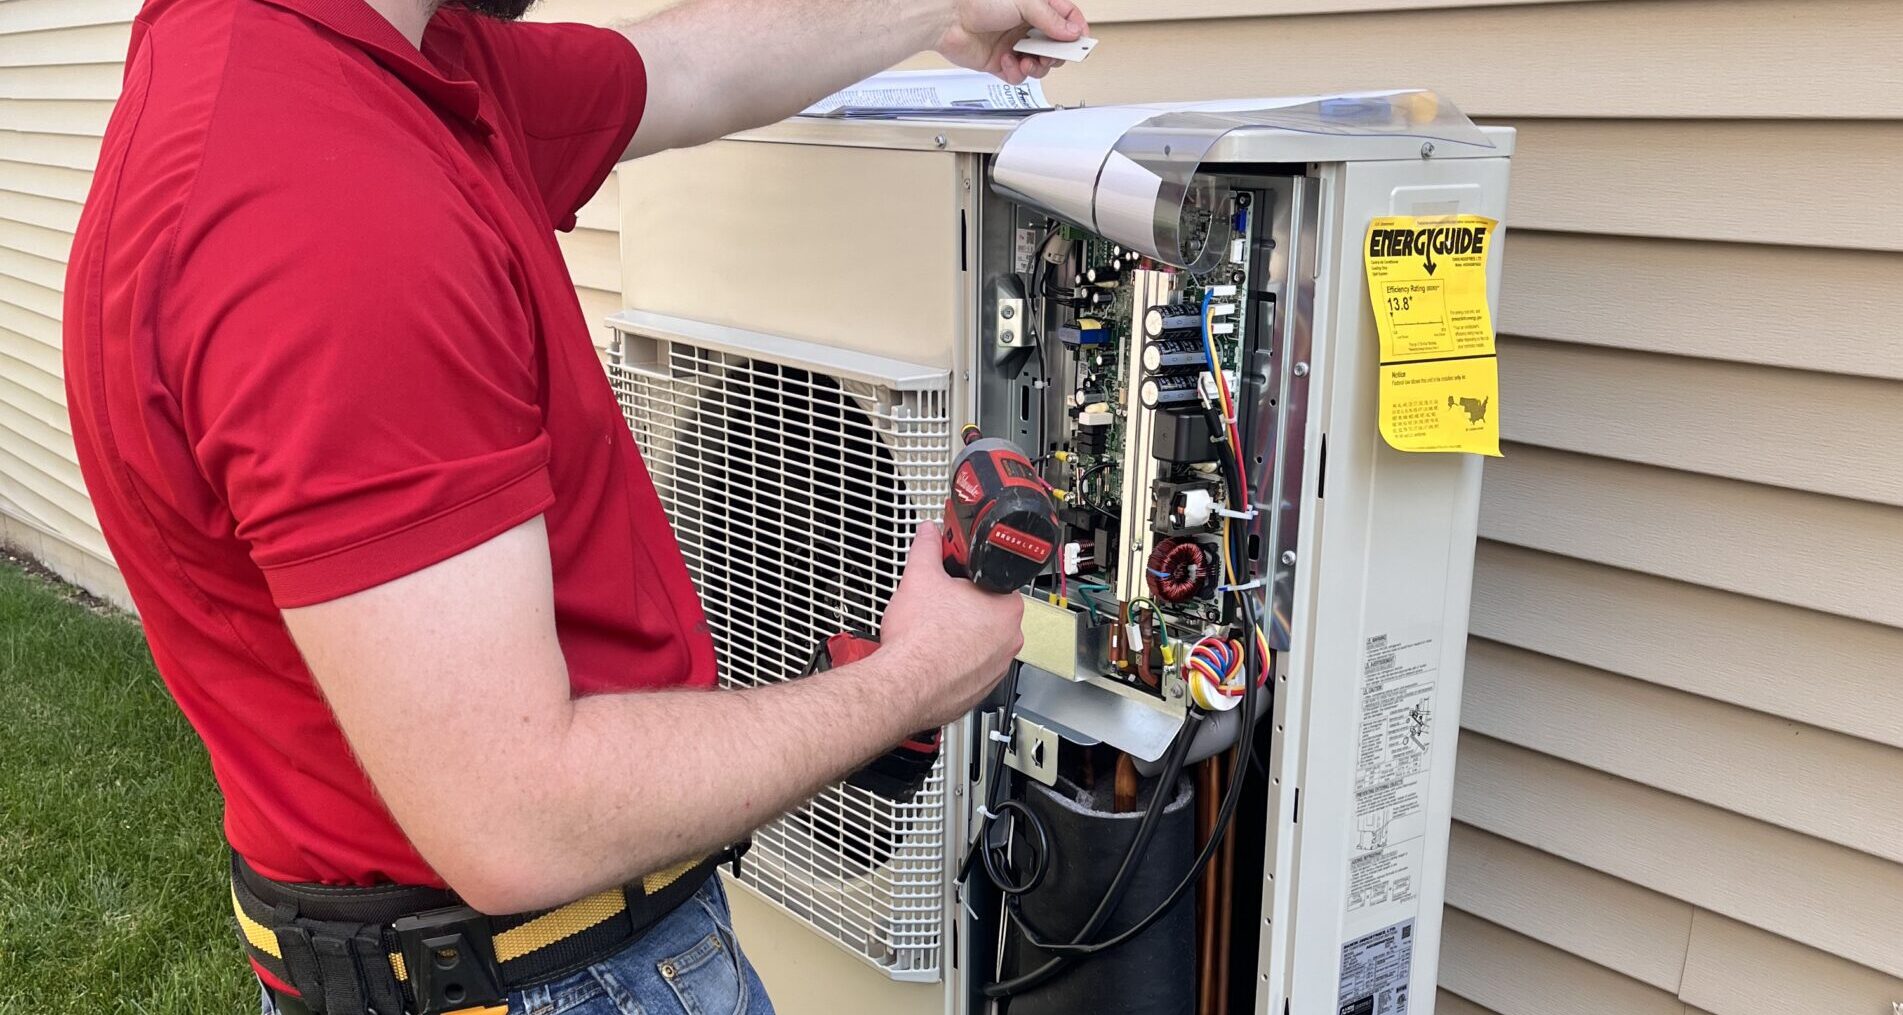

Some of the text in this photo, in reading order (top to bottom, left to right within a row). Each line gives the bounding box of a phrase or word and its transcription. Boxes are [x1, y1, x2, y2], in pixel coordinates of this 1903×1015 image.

[1370, 227, 1487, 258] ENERGYGUIDE
[1387, 285, 1409, 294] Efficiency
[1410, 285, 1425, 293] Rating
[995, 531, 1045, 555] BRUSHLESS
